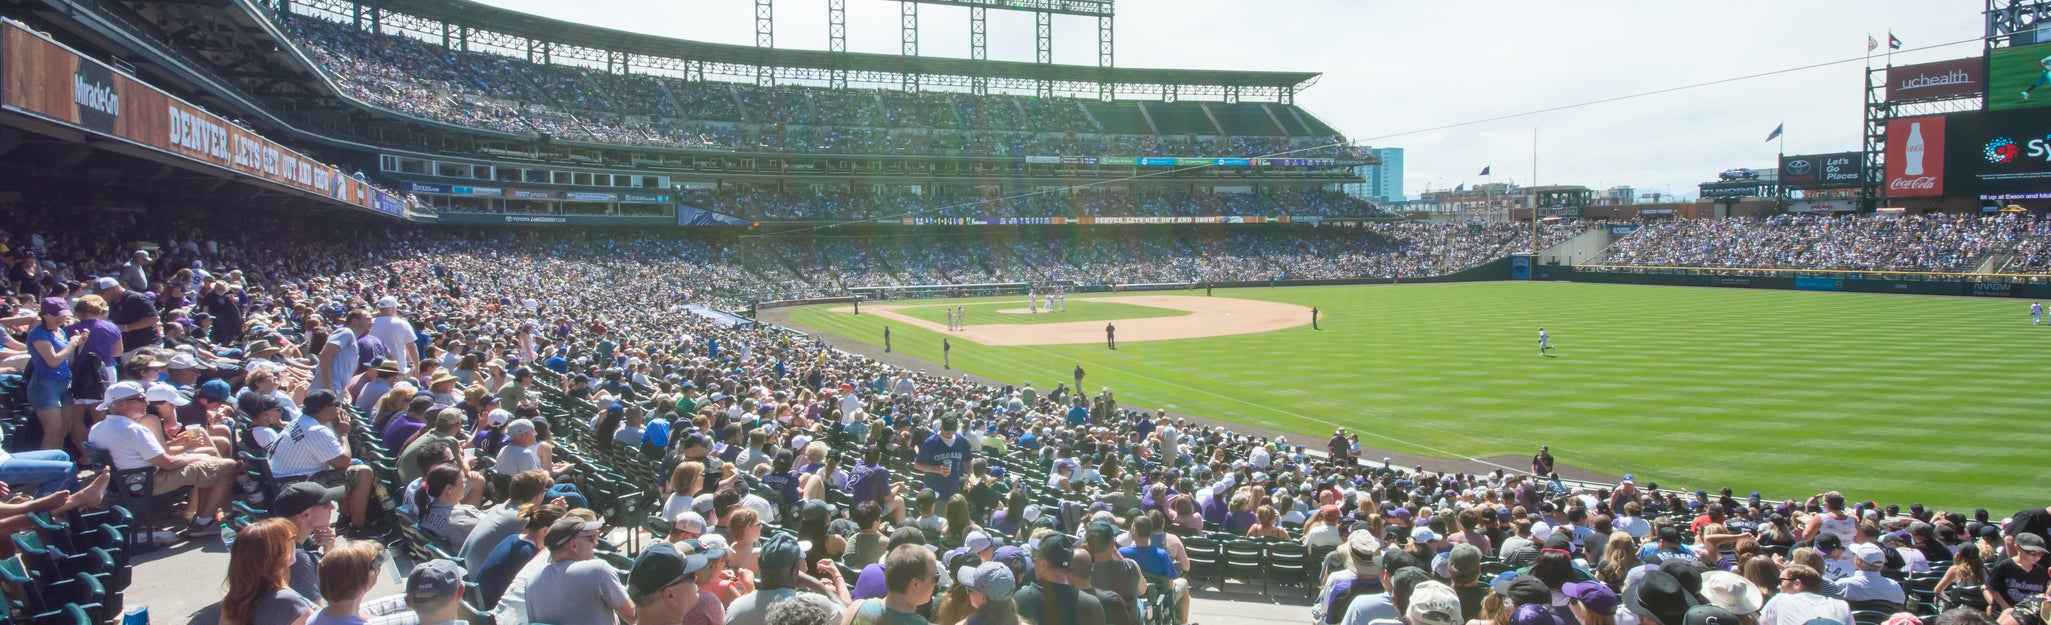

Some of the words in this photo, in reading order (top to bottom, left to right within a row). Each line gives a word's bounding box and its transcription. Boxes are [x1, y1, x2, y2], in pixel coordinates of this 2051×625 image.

[1902, 69, 1969, 89] uchealth
[169, 105, 231, 165] DENVER,
[234, 133, 261, 170] LETS
[263, 145, 279, 176] GET
[282, 154, 297, 181] OUT
[298, 160, 312, 186] AND
[314, 166, 330, 192] GROW
[1826, 157, 1849, 166] Let's
[1826, 165, 1840, 173] Go
[1826, 172, 1858, 180] Places
[1890, 176, 1937, 190] Coca-Cola
